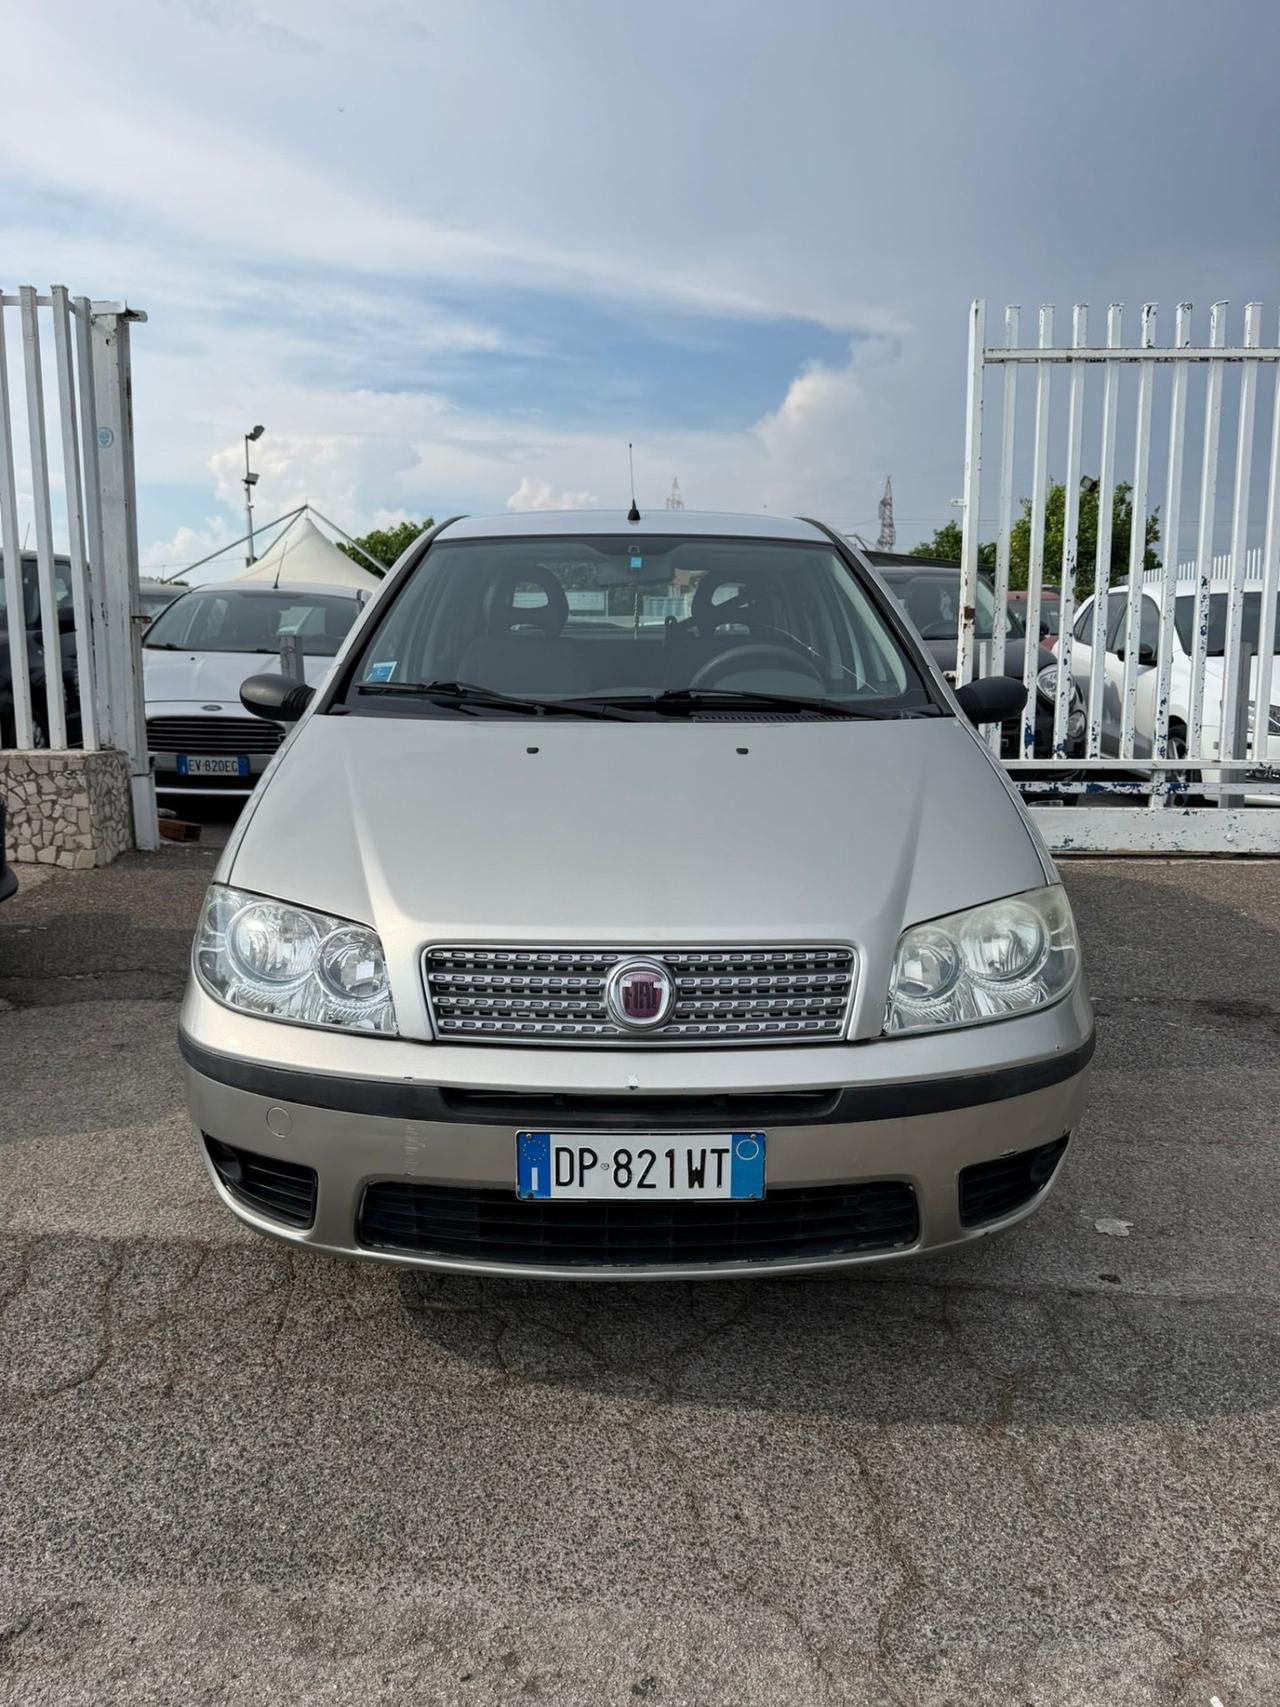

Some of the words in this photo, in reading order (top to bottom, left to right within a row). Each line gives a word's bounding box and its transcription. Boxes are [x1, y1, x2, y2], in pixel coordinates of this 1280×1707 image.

[189, 760, 201, 772] EV
[555, 1147, 598, 1188] DP
[613, 1148, 730, 1189] 821WT
